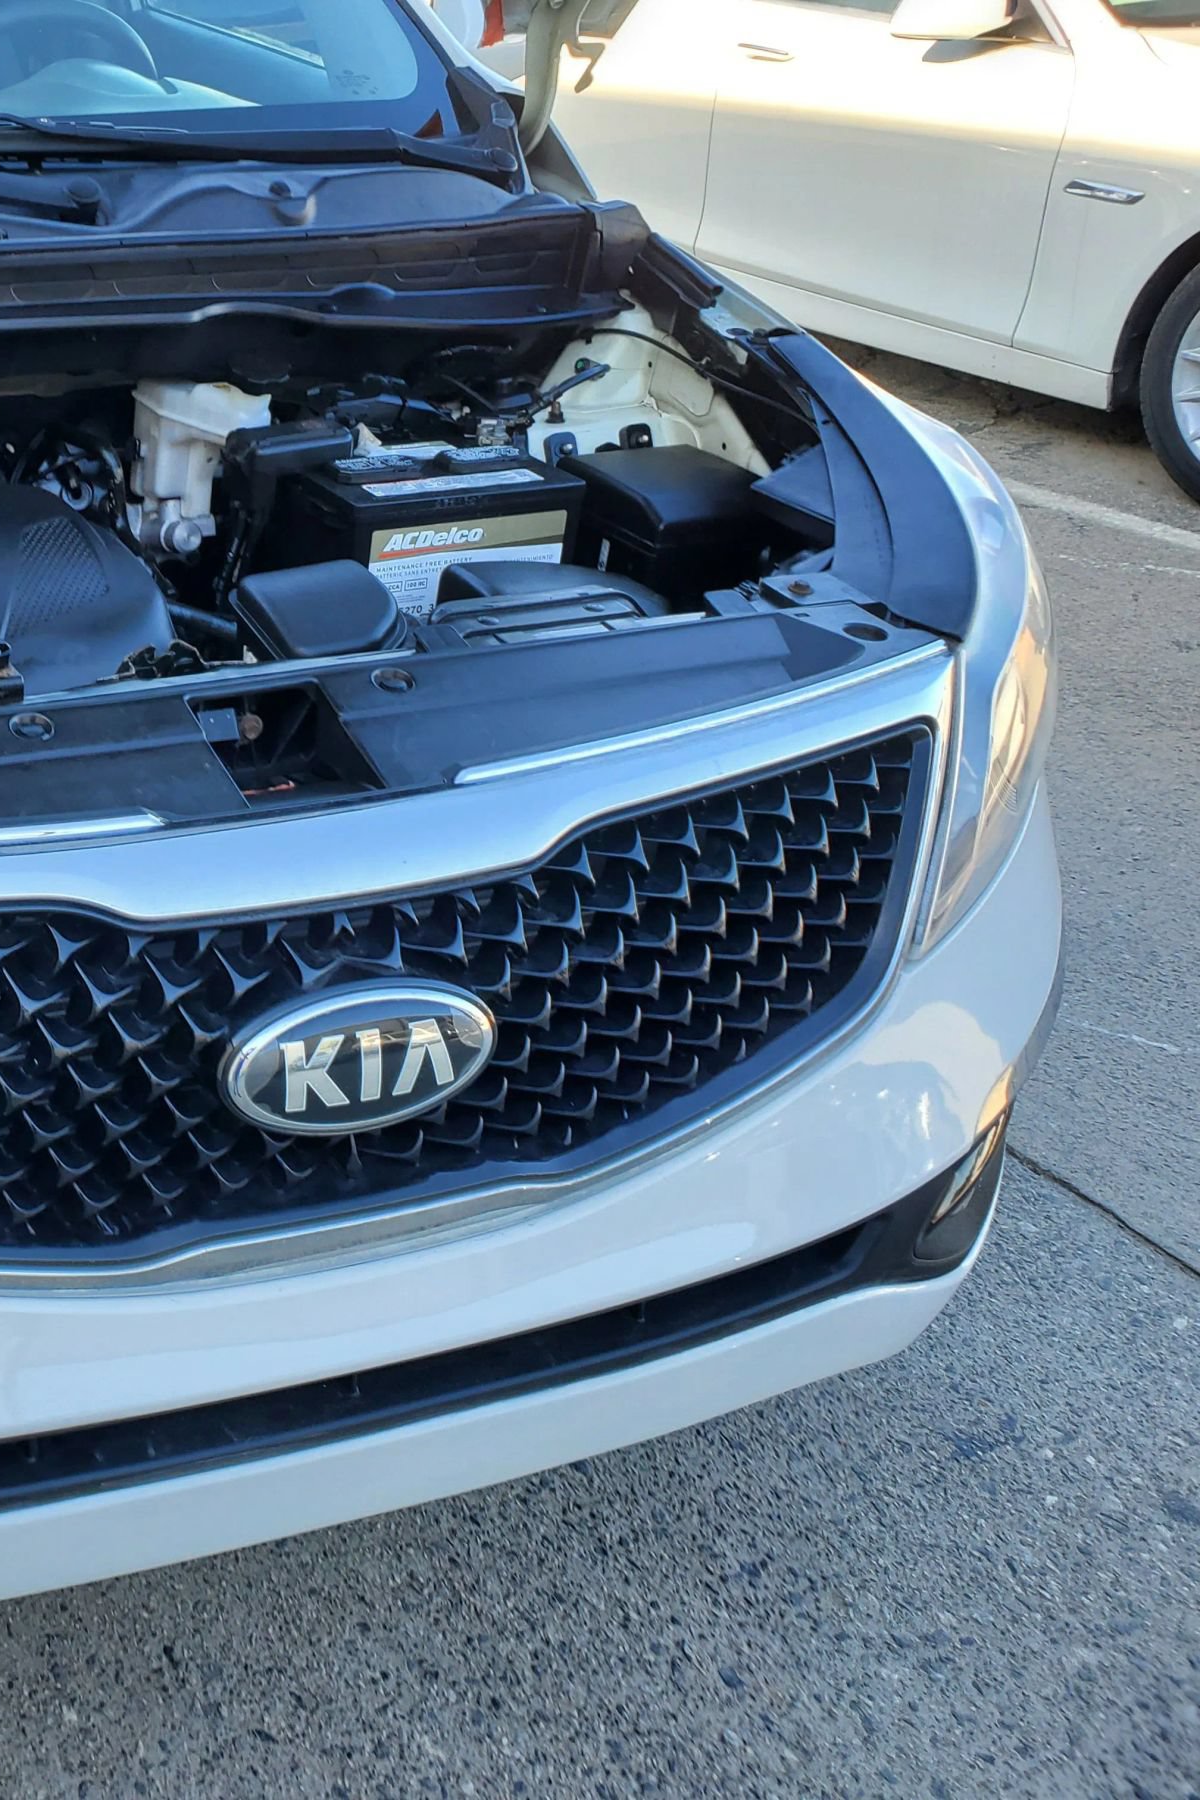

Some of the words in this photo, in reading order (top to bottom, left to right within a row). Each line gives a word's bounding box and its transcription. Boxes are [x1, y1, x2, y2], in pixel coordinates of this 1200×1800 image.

[382, 527, 484, 553] ACDelco
[376, 563, 422, 573] MAINTENANCE
[444, 557, 473, 565] BATTERY
[421, 567, 442, 575] ENTRET
[279, 1018, 455, 1113] KIA
